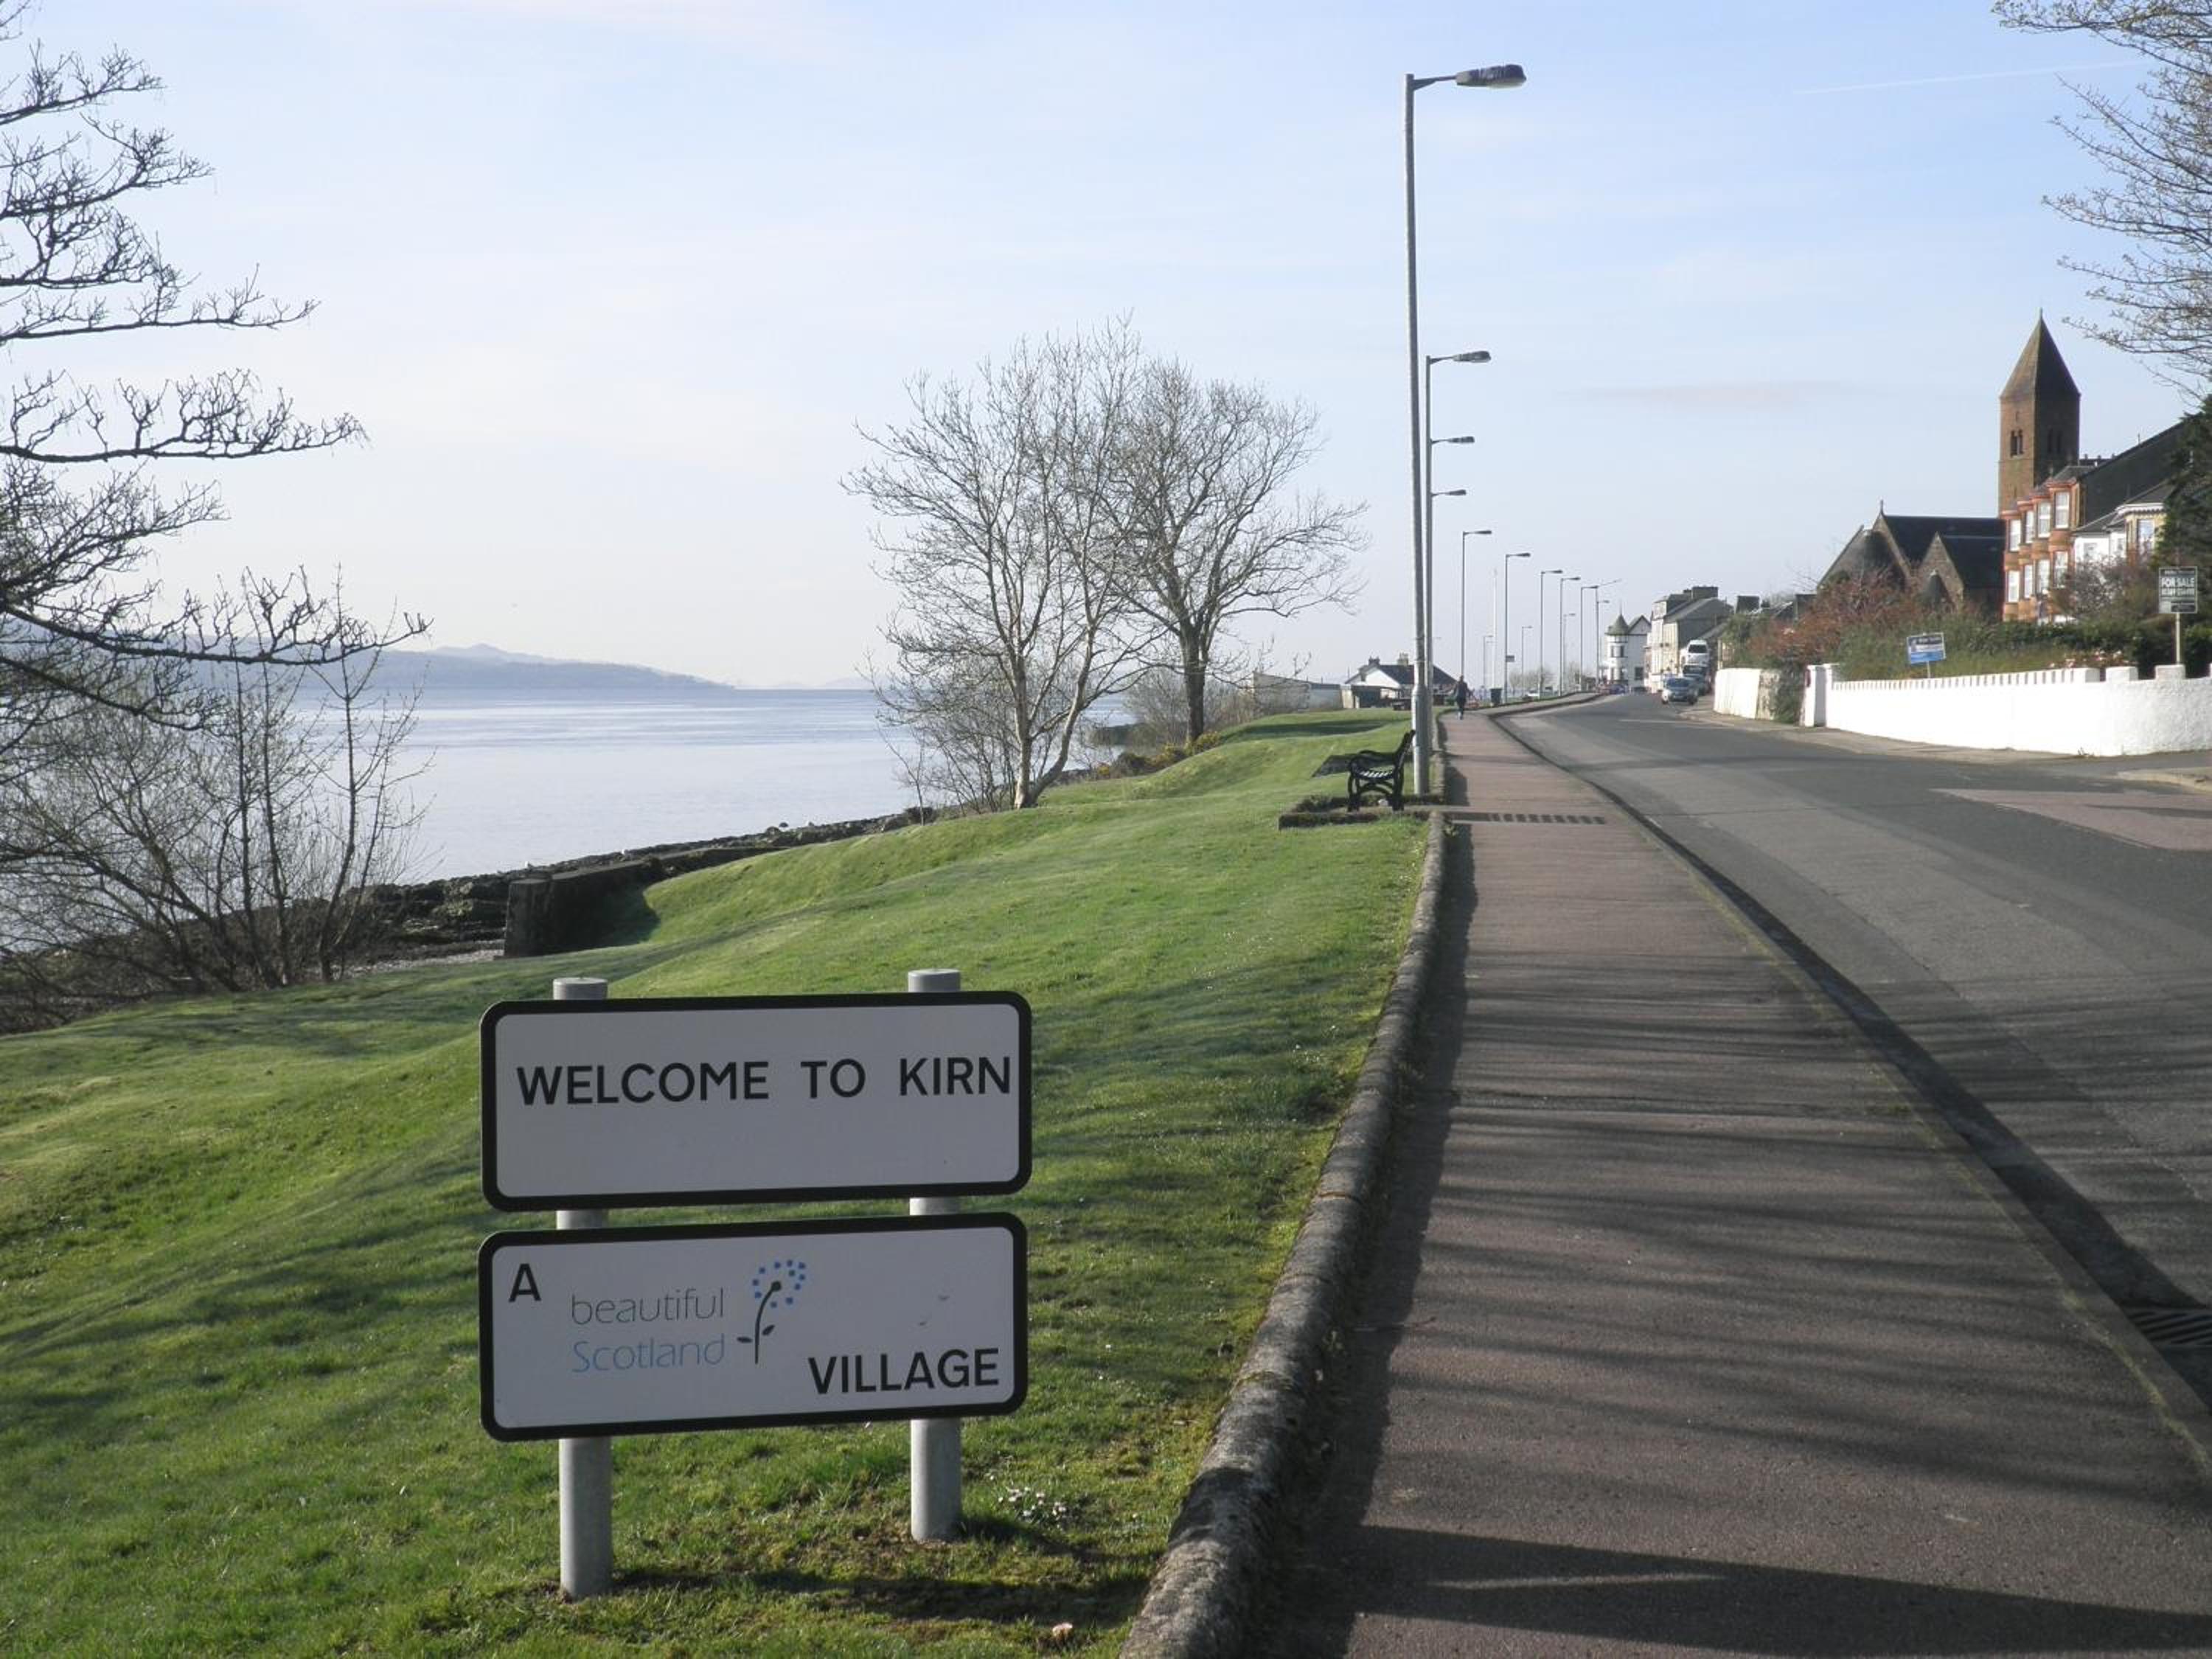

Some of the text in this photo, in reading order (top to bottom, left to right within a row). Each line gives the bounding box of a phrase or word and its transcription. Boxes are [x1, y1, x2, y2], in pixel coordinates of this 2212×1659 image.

[2161, 577, 2195, 588] FOR SALE
[517, 1057, 1011, 1105] WELCOME TO KIRN
[509, 1263, 541, 1303] A
[571, 1287, 725, 1326] beautiful
[572, 1334, 726, 1373] Scotland
[808, 1349, 1000, 1394] VILLAGE
